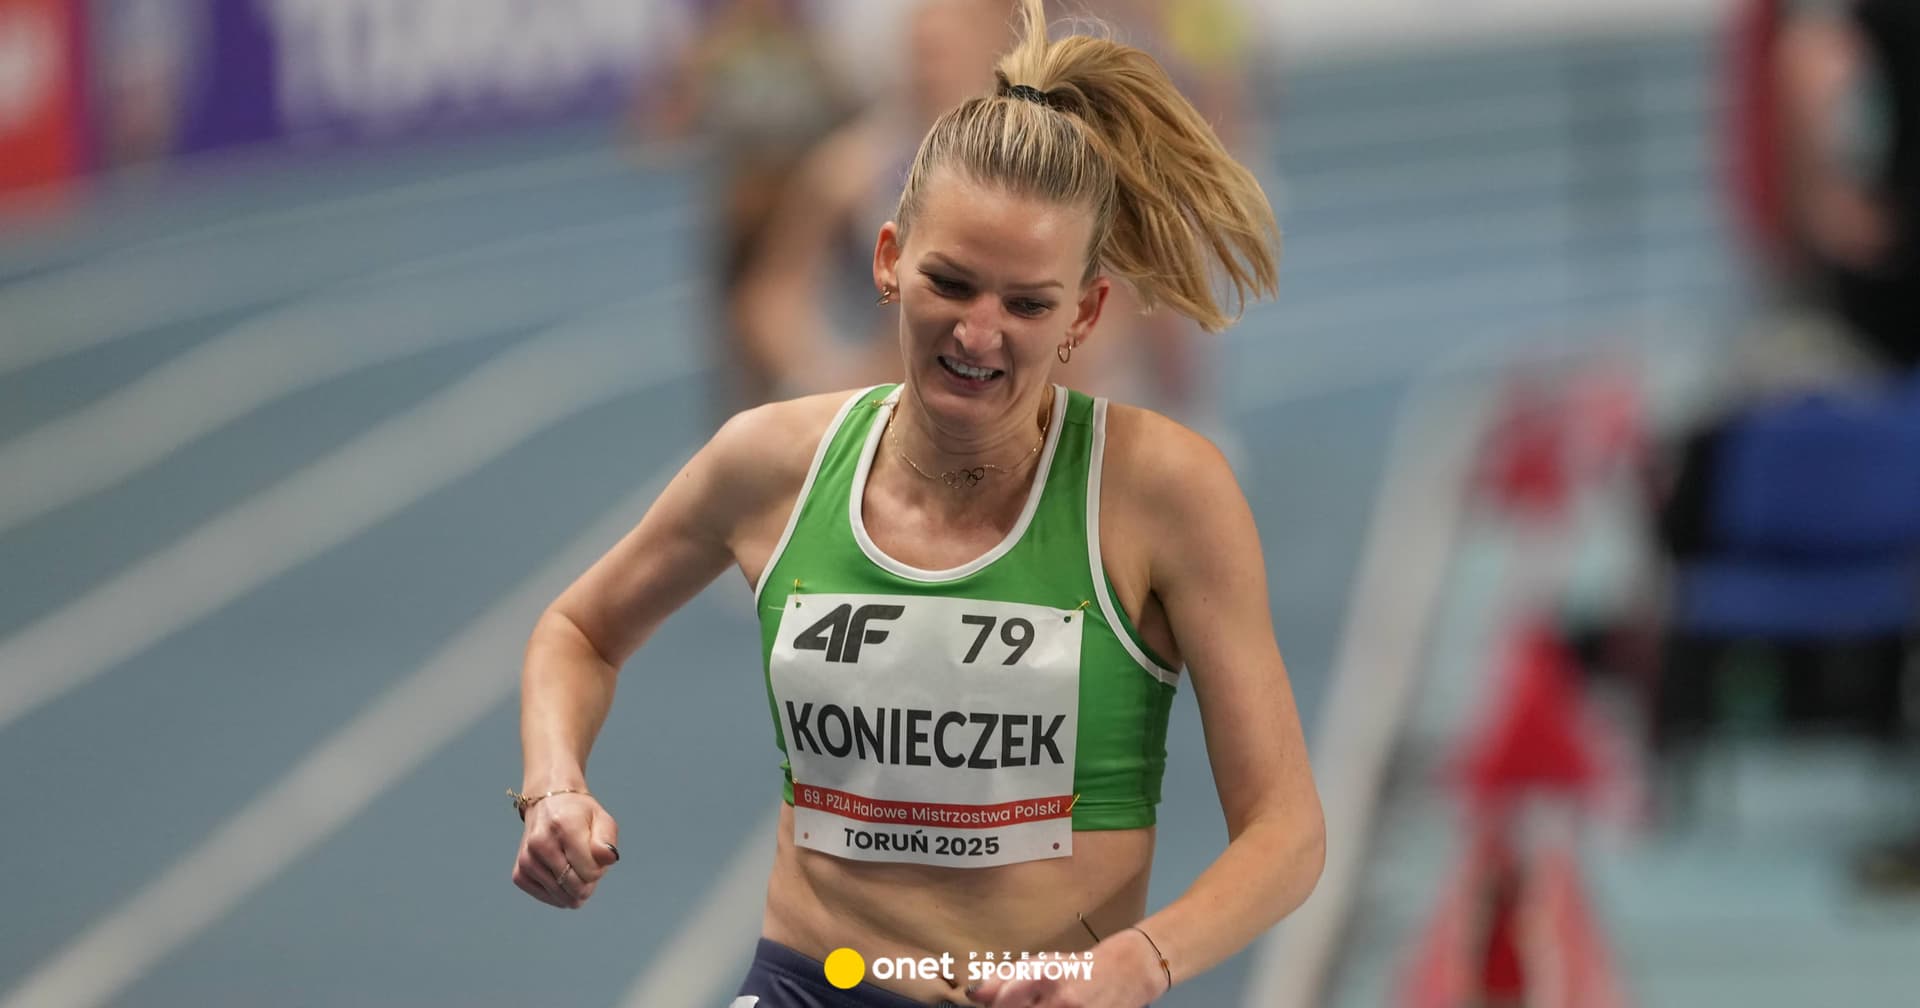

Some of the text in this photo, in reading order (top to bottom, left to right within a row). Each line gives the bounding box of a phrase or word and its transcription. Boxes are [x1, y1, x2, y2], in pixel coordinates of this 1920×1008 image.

[793, 603, 1035, 665] 4F 79
[785, 701, 1066, 769] KONIECZEK
[804, 789, 1060, 823] 69. PZLA Halowe Mistrzostwa Polski
[844, 827, 1000, 856] TORUŃ 2025
